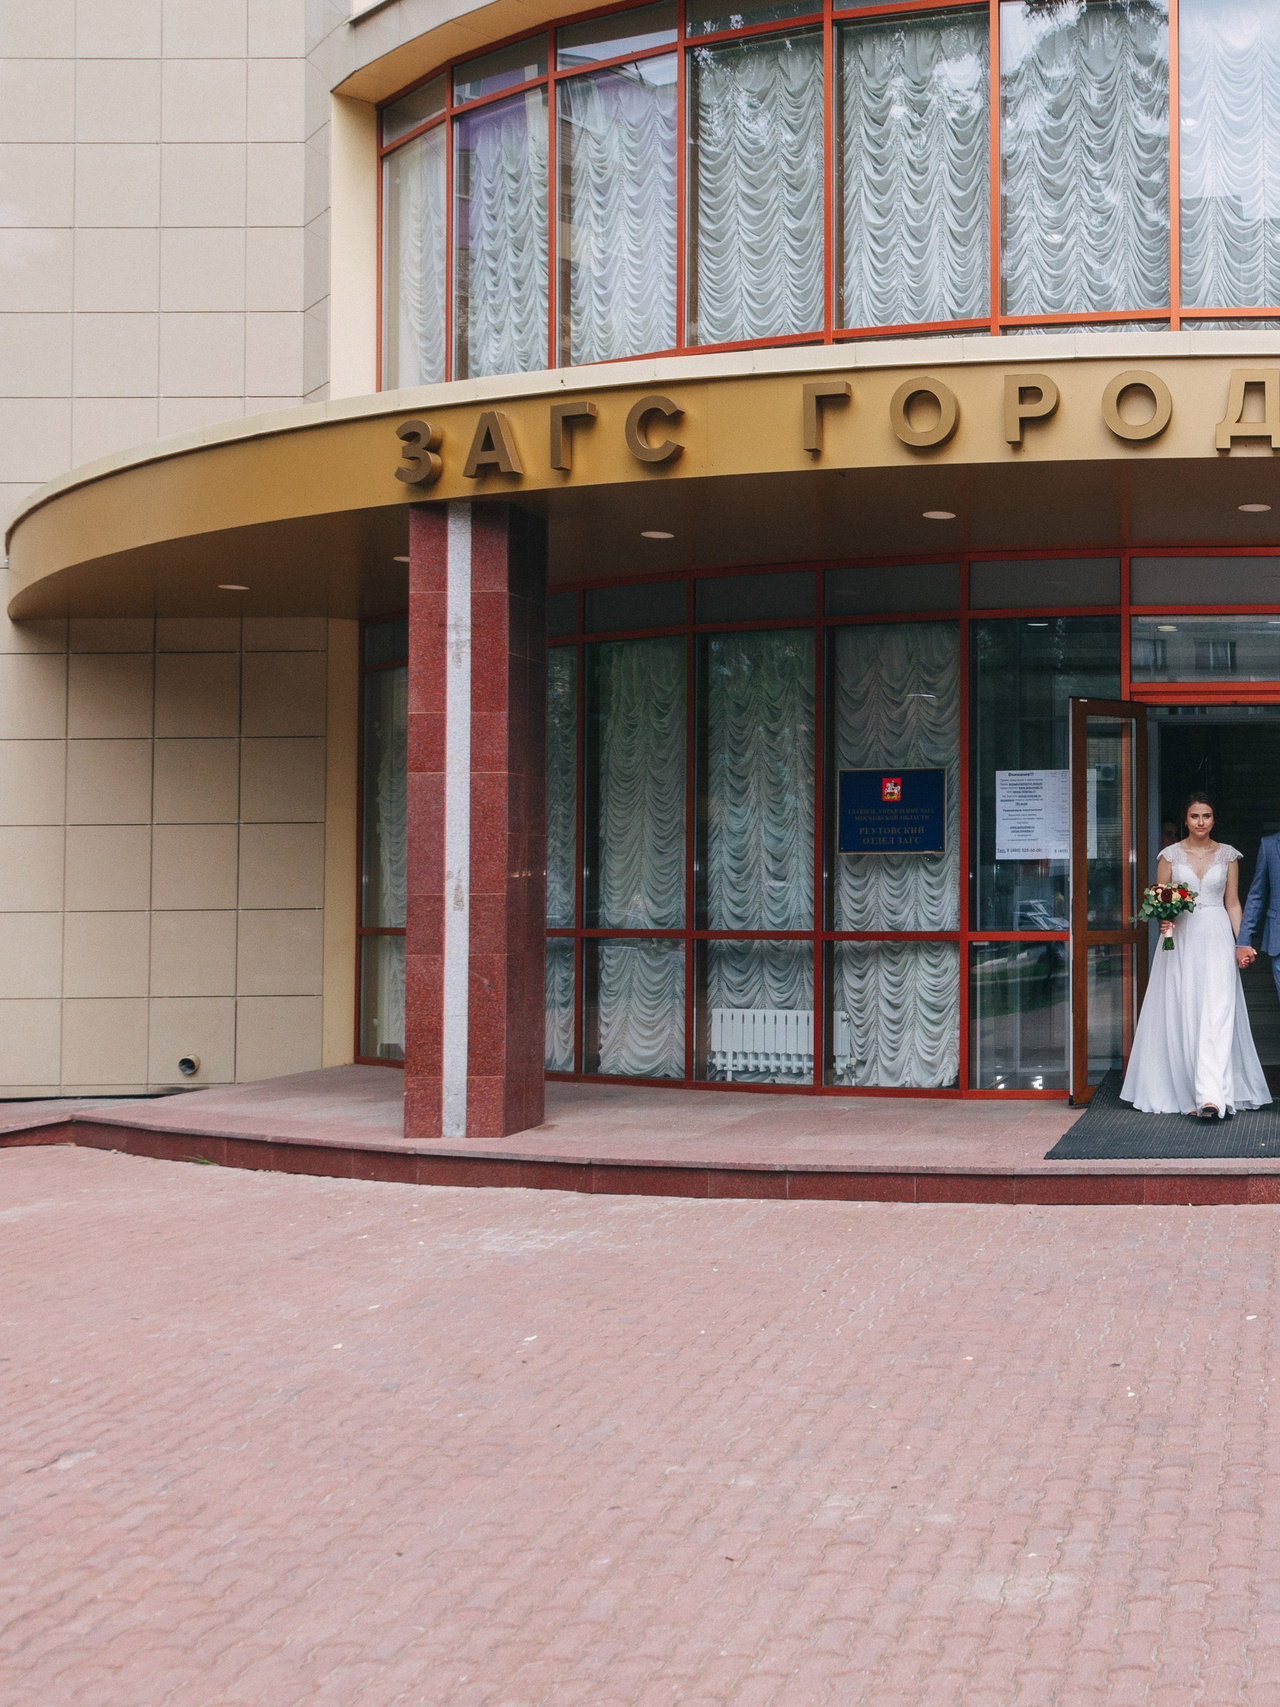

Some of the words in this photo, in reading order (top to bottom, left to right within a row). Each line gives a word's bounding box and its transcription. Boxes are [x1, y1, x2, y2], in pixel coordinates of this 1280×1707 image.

[394, 394, 687, 485] ЗАГС
[859, 825, 924, 835] РЕУТОВСКИЙ
[862, 836, 895, 845] ОТДЕЛ
[898, 836, 921, 845] ЗАГС
